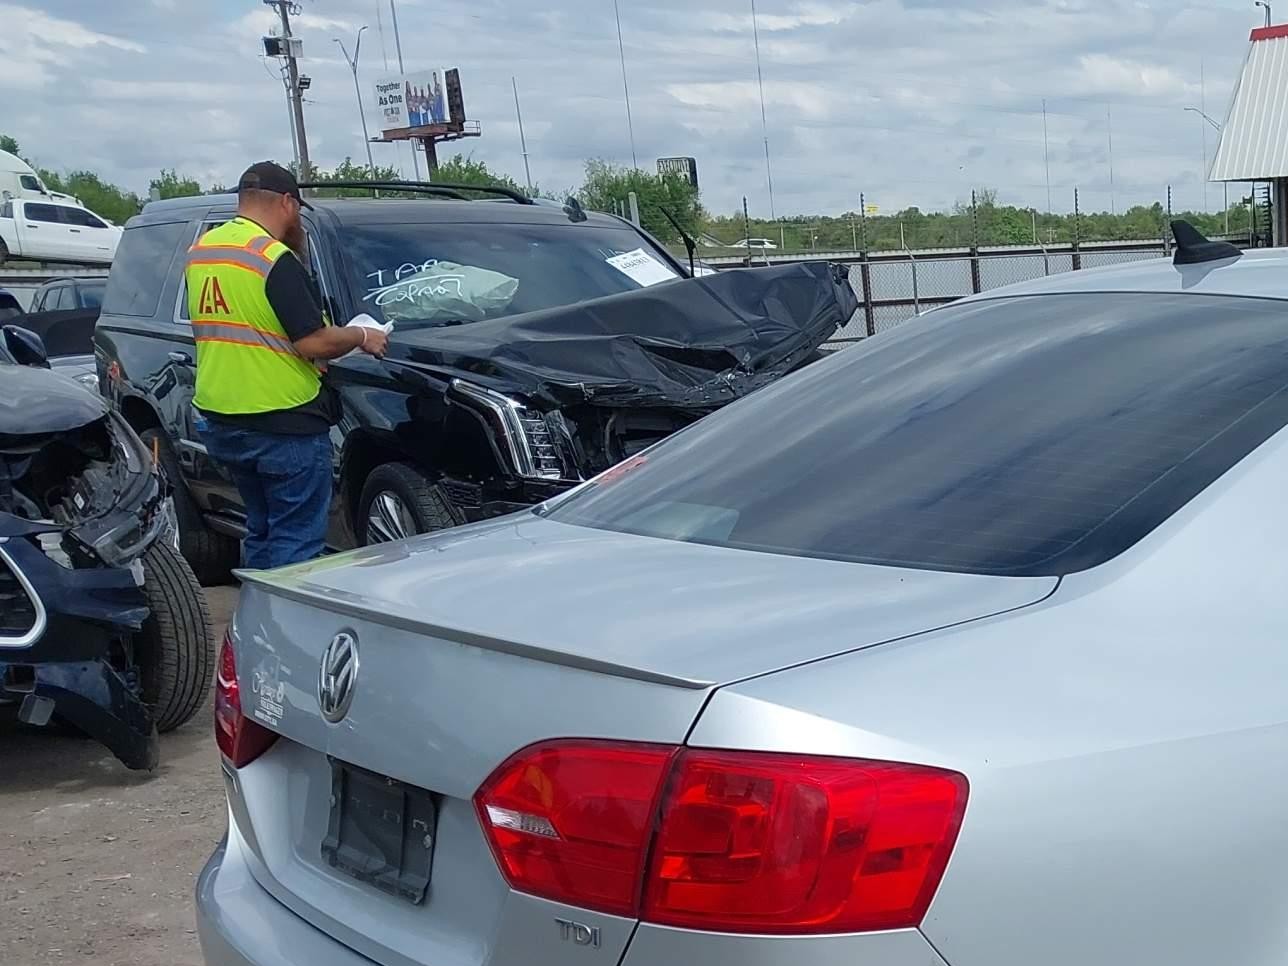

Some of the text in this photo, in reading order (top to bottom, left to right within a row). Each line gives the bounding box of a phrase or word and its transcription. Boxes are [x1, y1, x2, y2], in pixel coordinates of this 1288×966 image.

[376, 83, 400, 93] Together
[379, 94, 402, 106] As One
[554, 917, 601, 950] TDI
